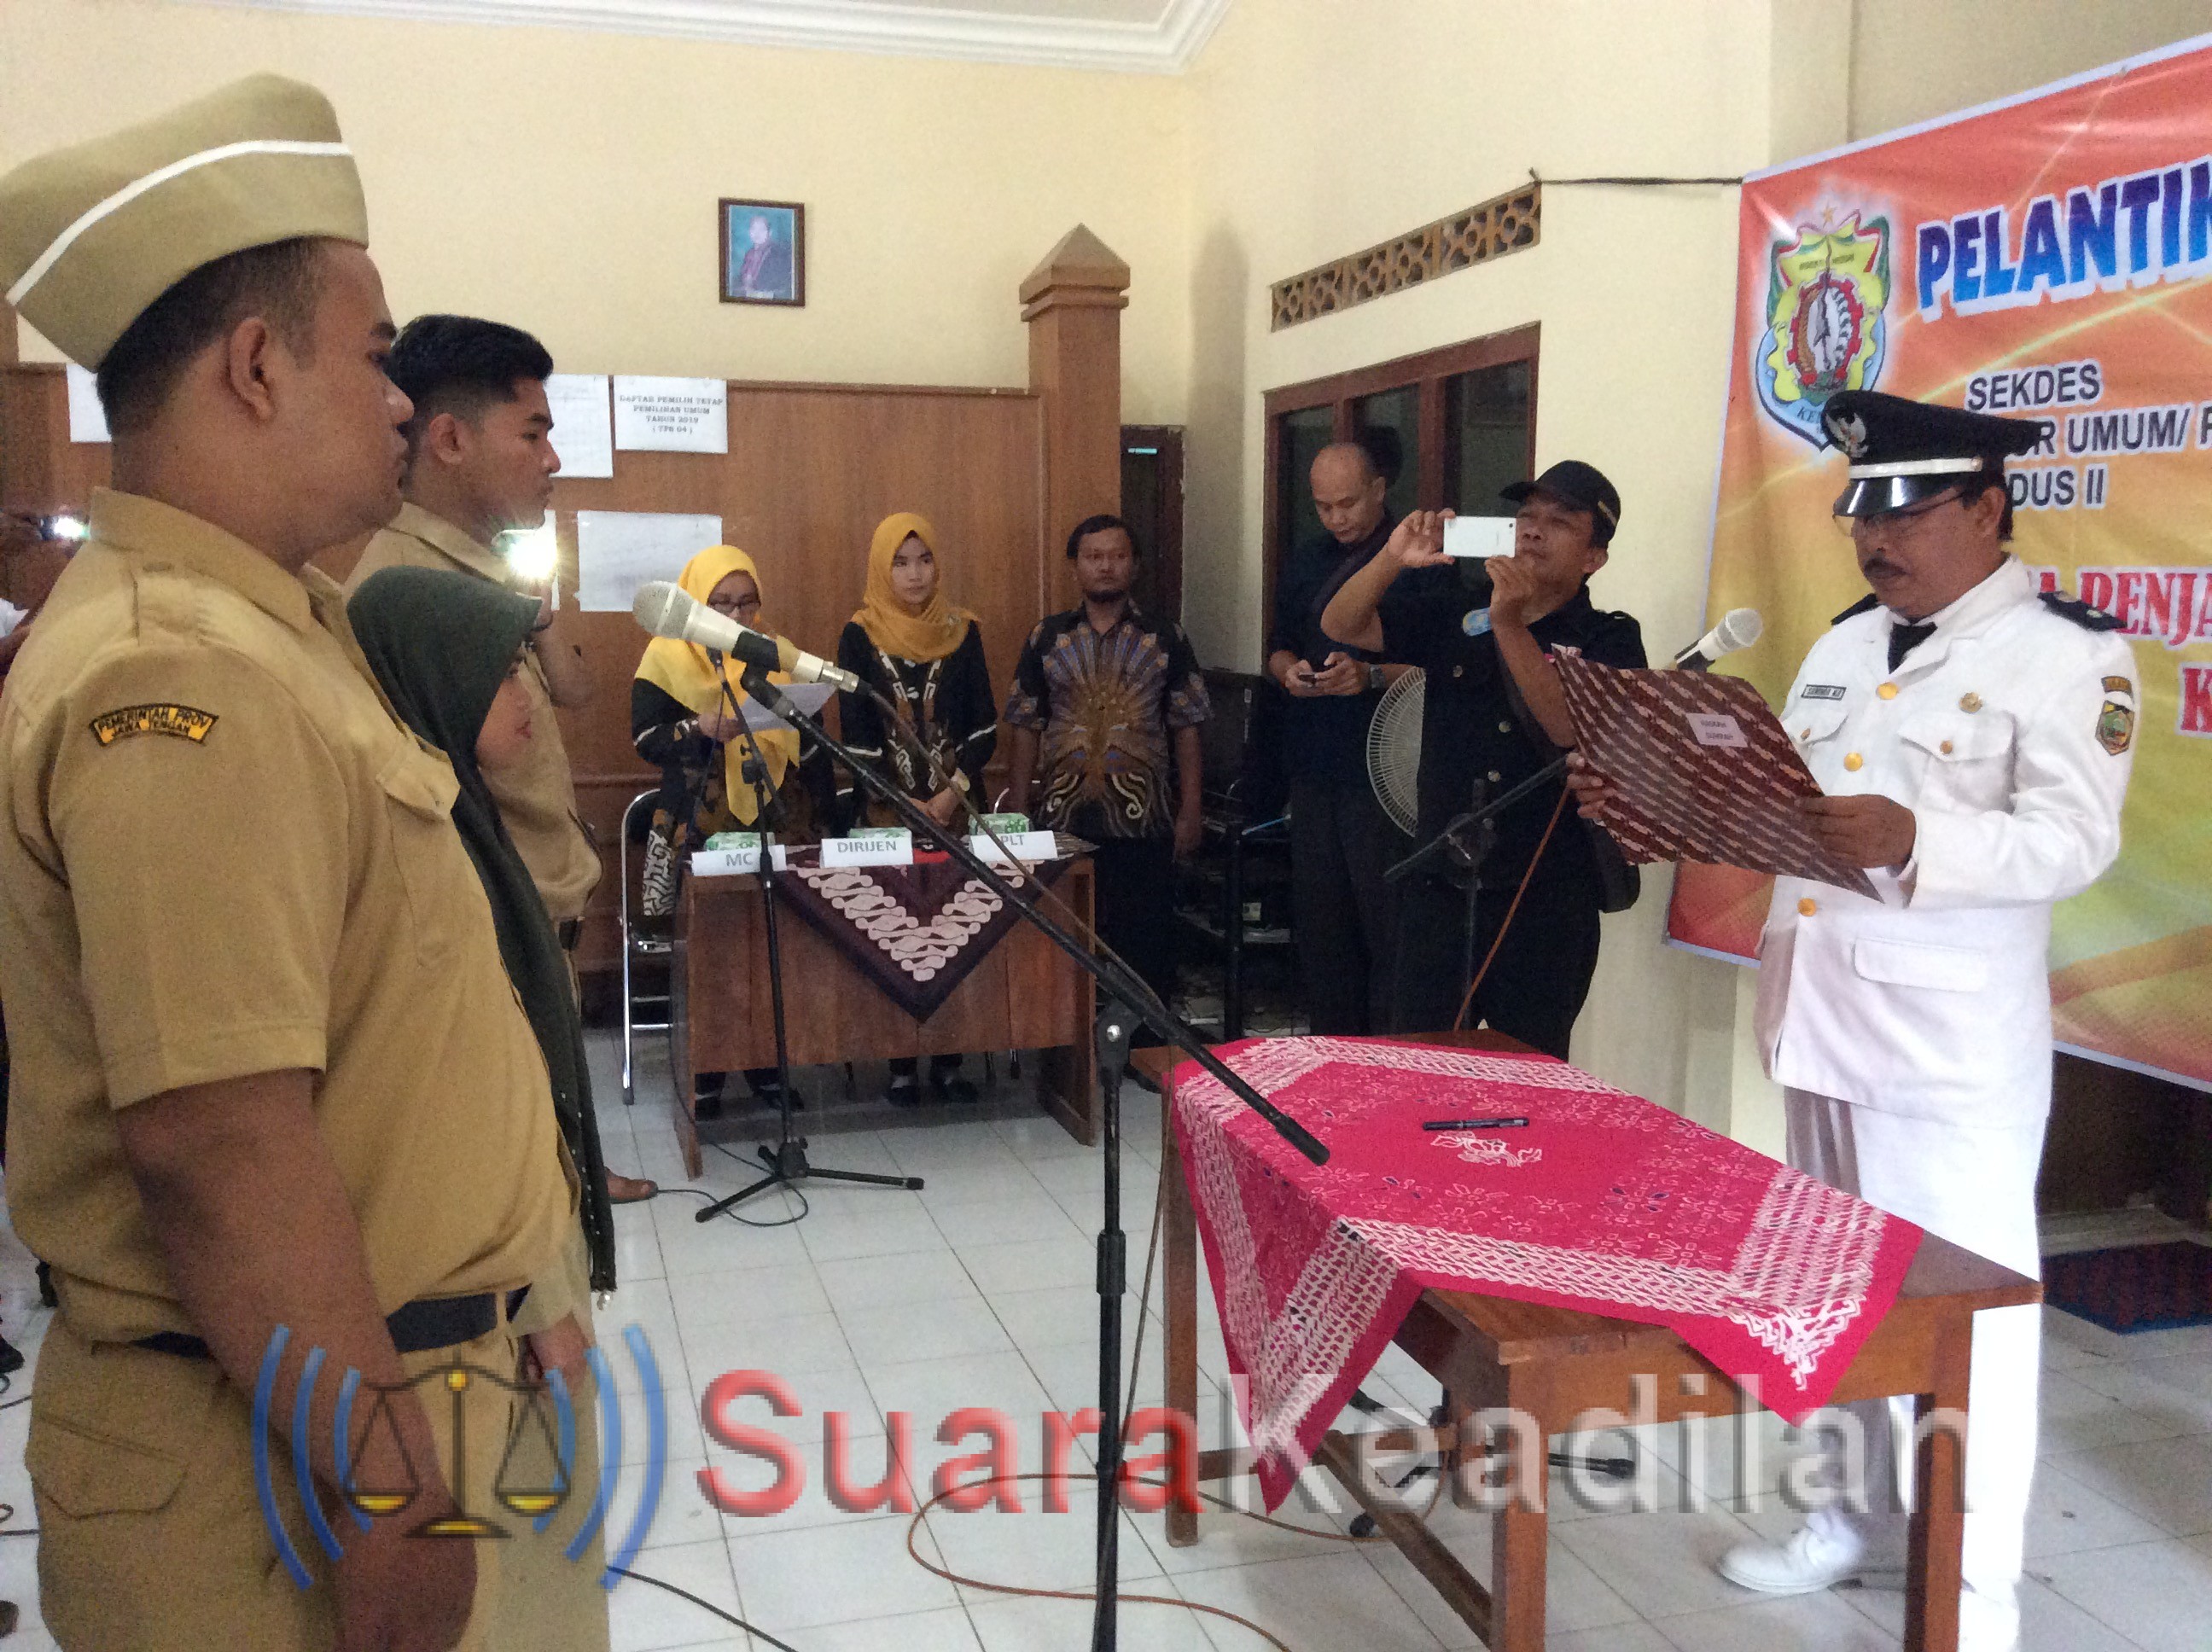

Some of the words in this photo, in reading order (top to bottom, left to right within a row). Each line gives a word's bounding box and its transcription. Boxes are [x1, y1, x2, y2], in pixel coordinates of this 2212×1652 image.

[1967, 363, 2100, 411] SEKDES
[633, 404, 681, 413] PEMILIHAN
[2068, 408, 2191, 454] UMUM/
[2086, 468, 2105, 505] II
[725, 852, 754, 868] MC
[836, 841, 897, 853] DIRIJEN
